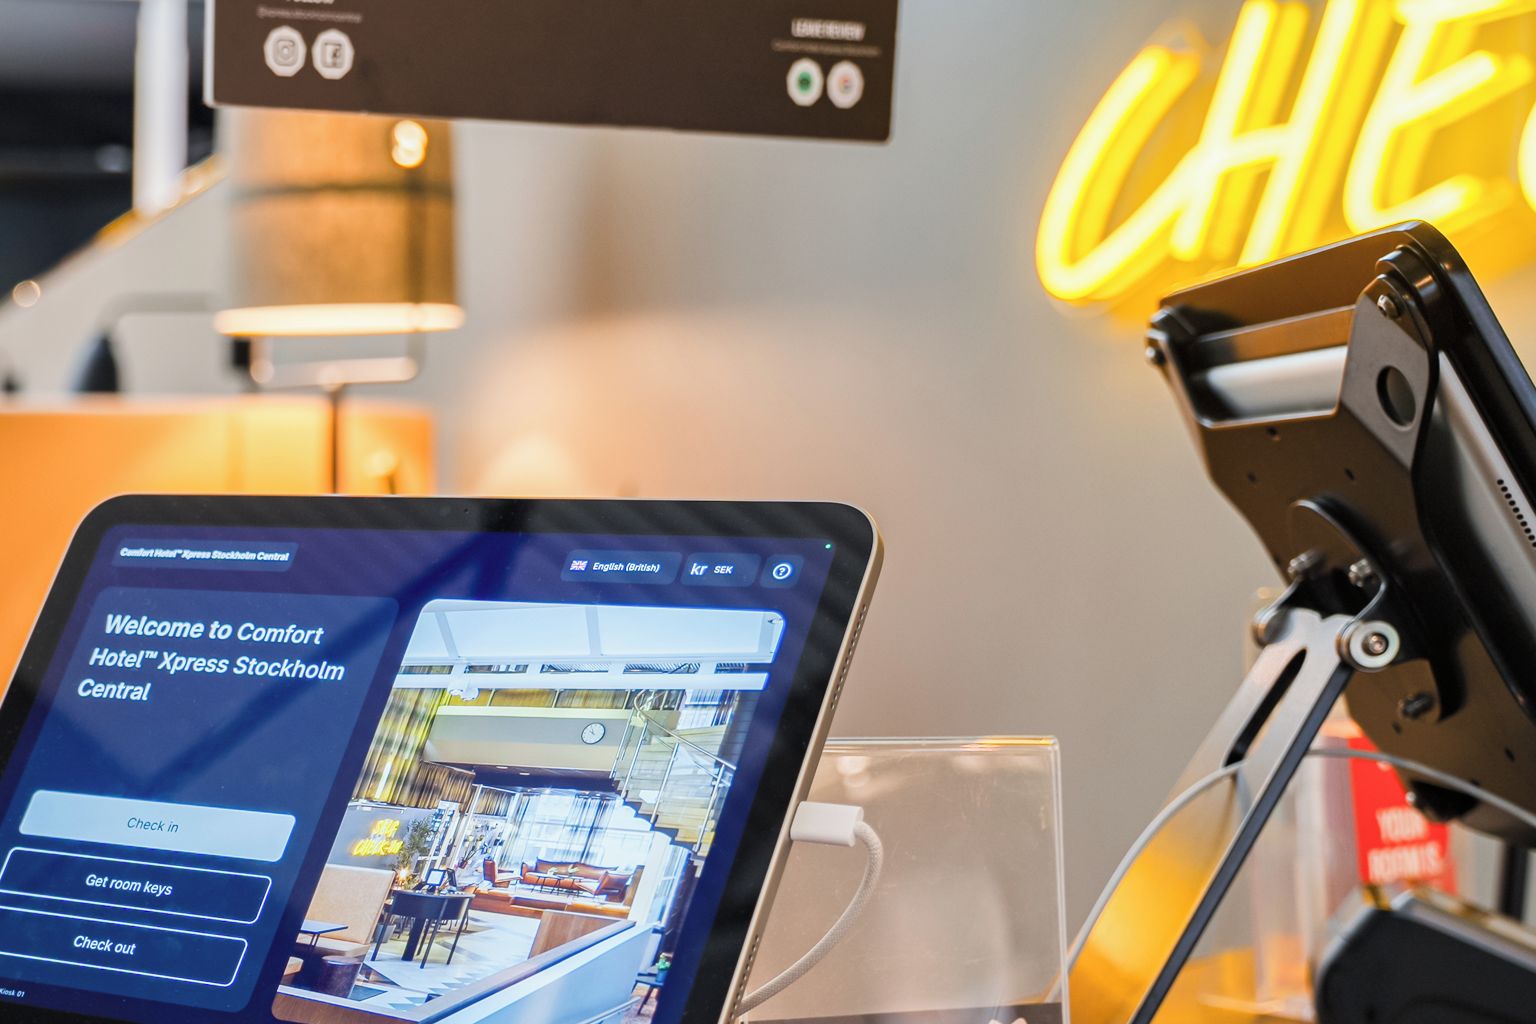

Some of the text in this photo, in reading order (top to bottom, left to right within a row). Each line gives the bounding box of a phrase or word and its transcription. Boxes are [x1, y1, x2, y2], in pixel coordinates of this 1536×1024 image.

[1036, 0, 1536, 300] CHE
[120, 547, 154, 557] Comfort
[212, 550, 256, 560] Stockholm
[257, 552, 289, 561] Central
[592, 562, 661, 574] English (British)
[690, 563, 708, 575] kr
[714, 565, 733, 575] SEK
[105, 613, 324, 645] Welcome to Comfort
[157, 651, 229, 675] Xpress
[233, 656, 345, 681] Stockholm
[77, 678, 151, 701] Central
[127, 817, 179, 833] Check in
[85, 874, 173, 897] Get room keys
[73, 935, 136, 955] Check out
[16, 990, 25, 998] 01
